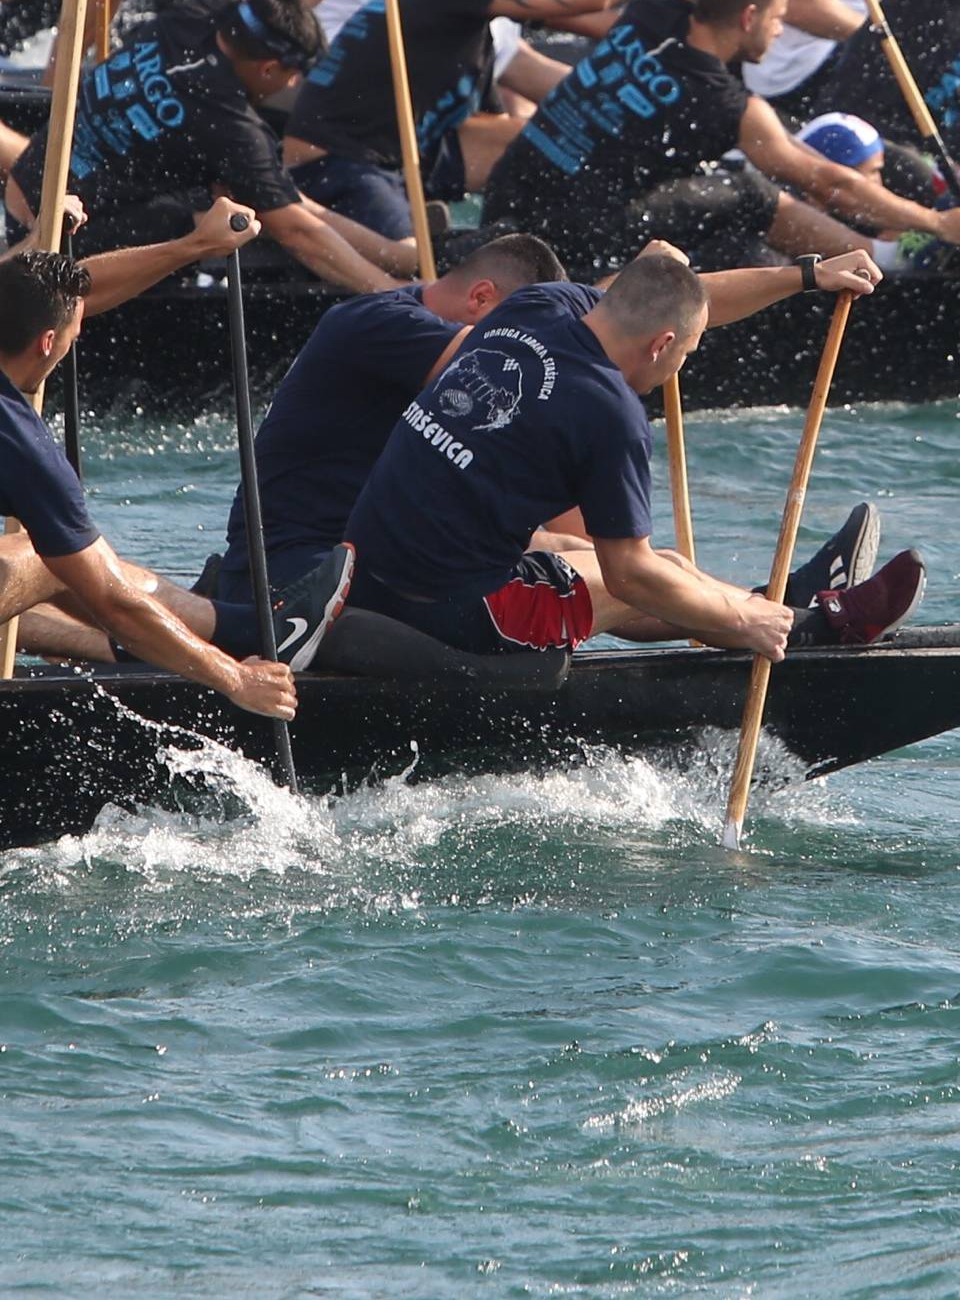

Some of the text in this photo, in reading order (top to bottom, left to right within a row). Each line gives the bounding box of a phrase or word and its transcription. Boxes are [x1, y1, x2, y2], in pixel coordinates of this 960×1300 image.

[133, 41, 186, 128] ARGO
[610, 24, 681, 105] ARGO
[483, 326, 520, 340] UDRUGA
[401, 401, 475, 470] STAŠEVICA
